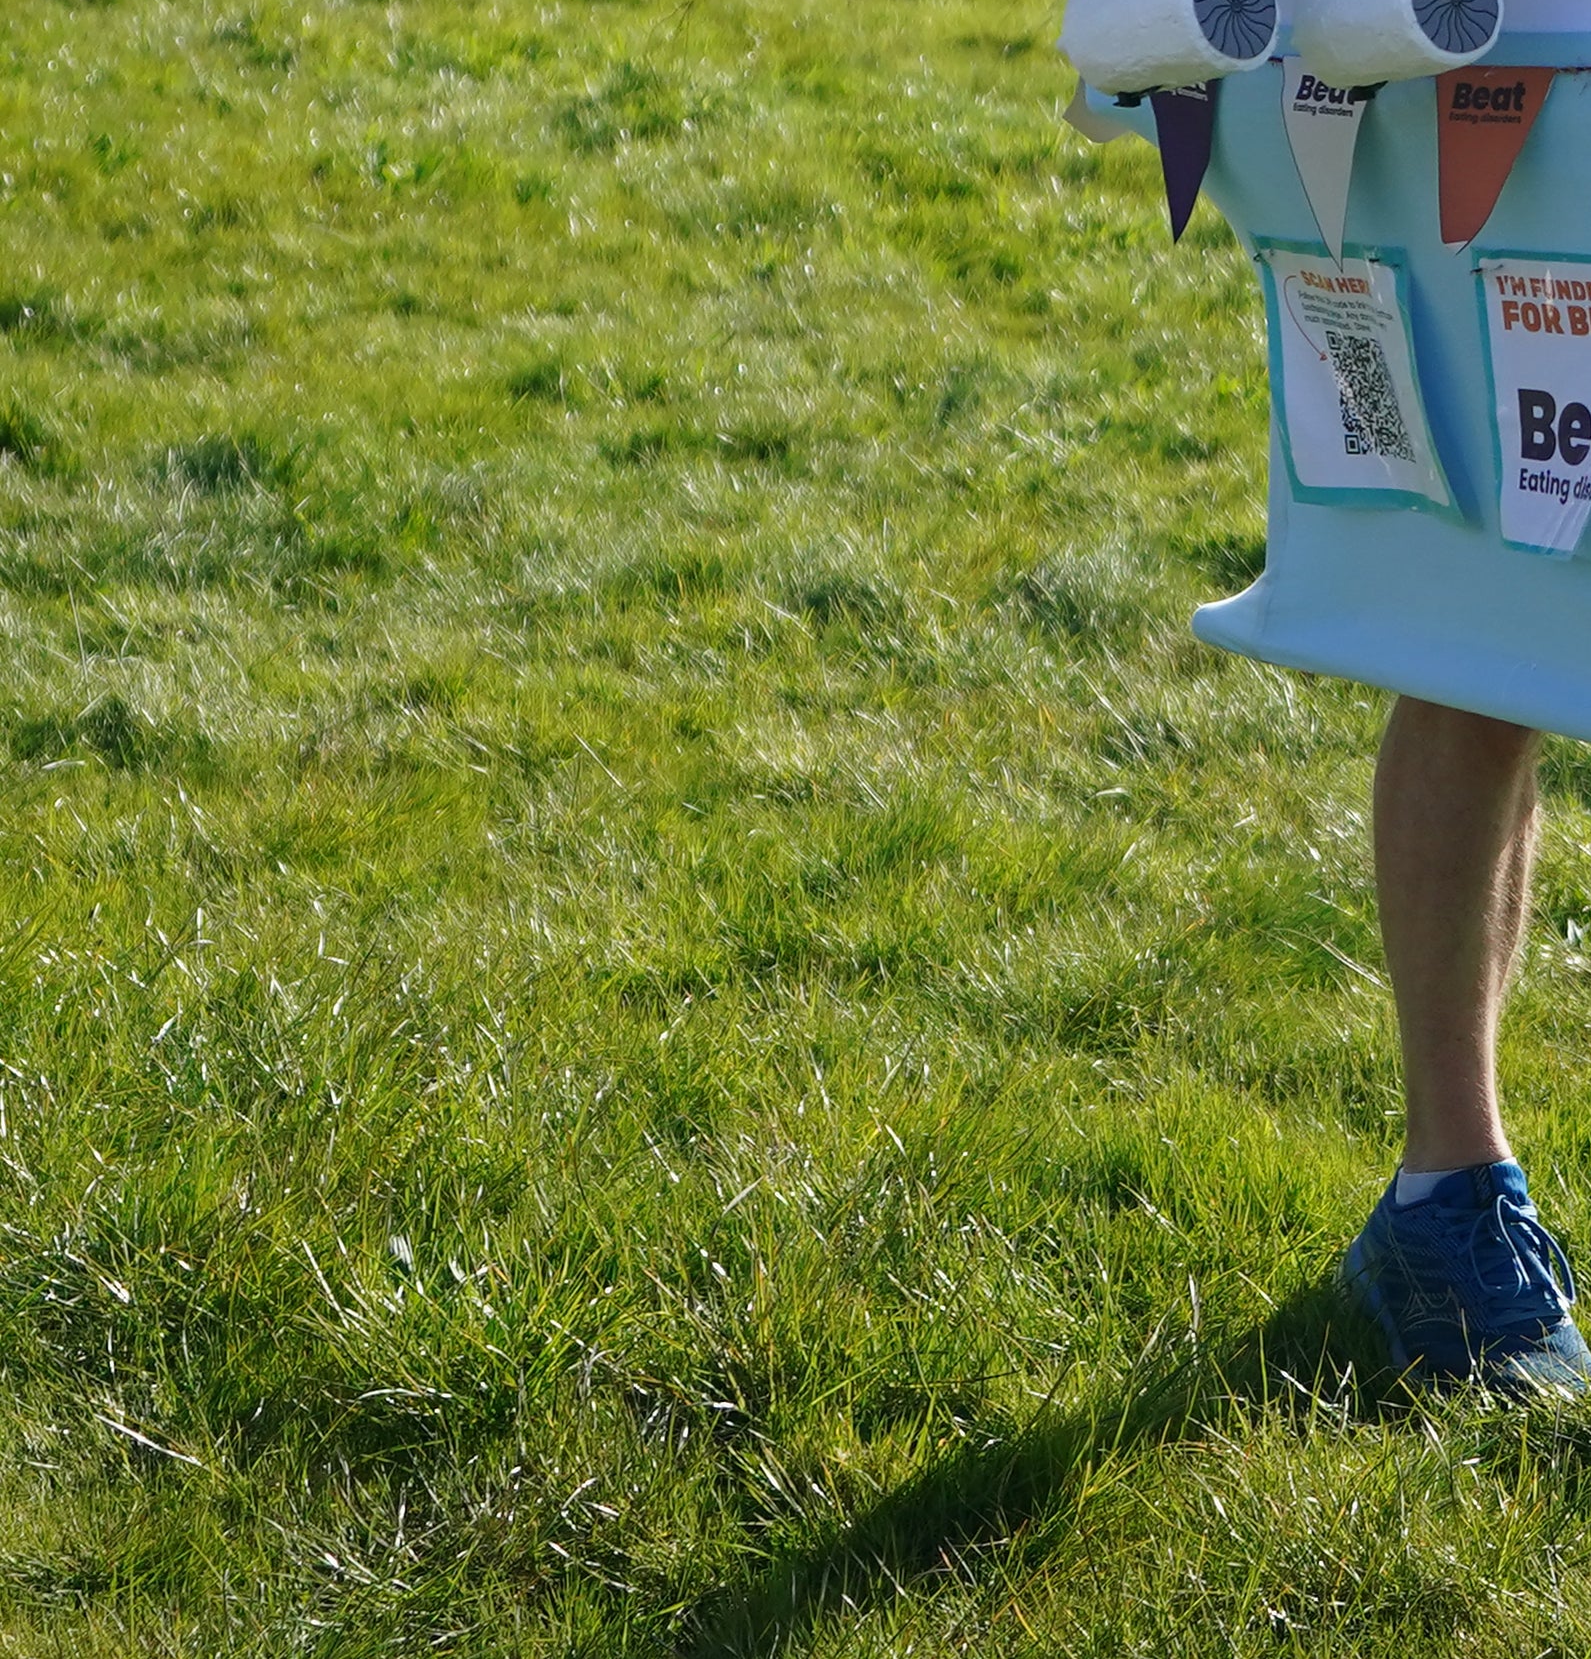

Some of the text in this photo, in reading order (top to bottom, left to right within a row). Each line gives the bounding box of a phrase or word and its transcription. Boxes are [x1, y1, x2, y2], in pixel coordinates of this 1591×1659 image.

[1295, 74, 1356, 106] Bea
[1452, 81, 1526, 111] Beat
[1293, 102, 1354, 118] Eating disorders
[1449, 110, 1522, 125] Eating disorders
[1301, 270, 1336, 293] SCAN
[1496, 276, 1525, 296] I'M
[1502, 300, 1564, 335] FOR
[1518, 467, 1571, 505] Eating
